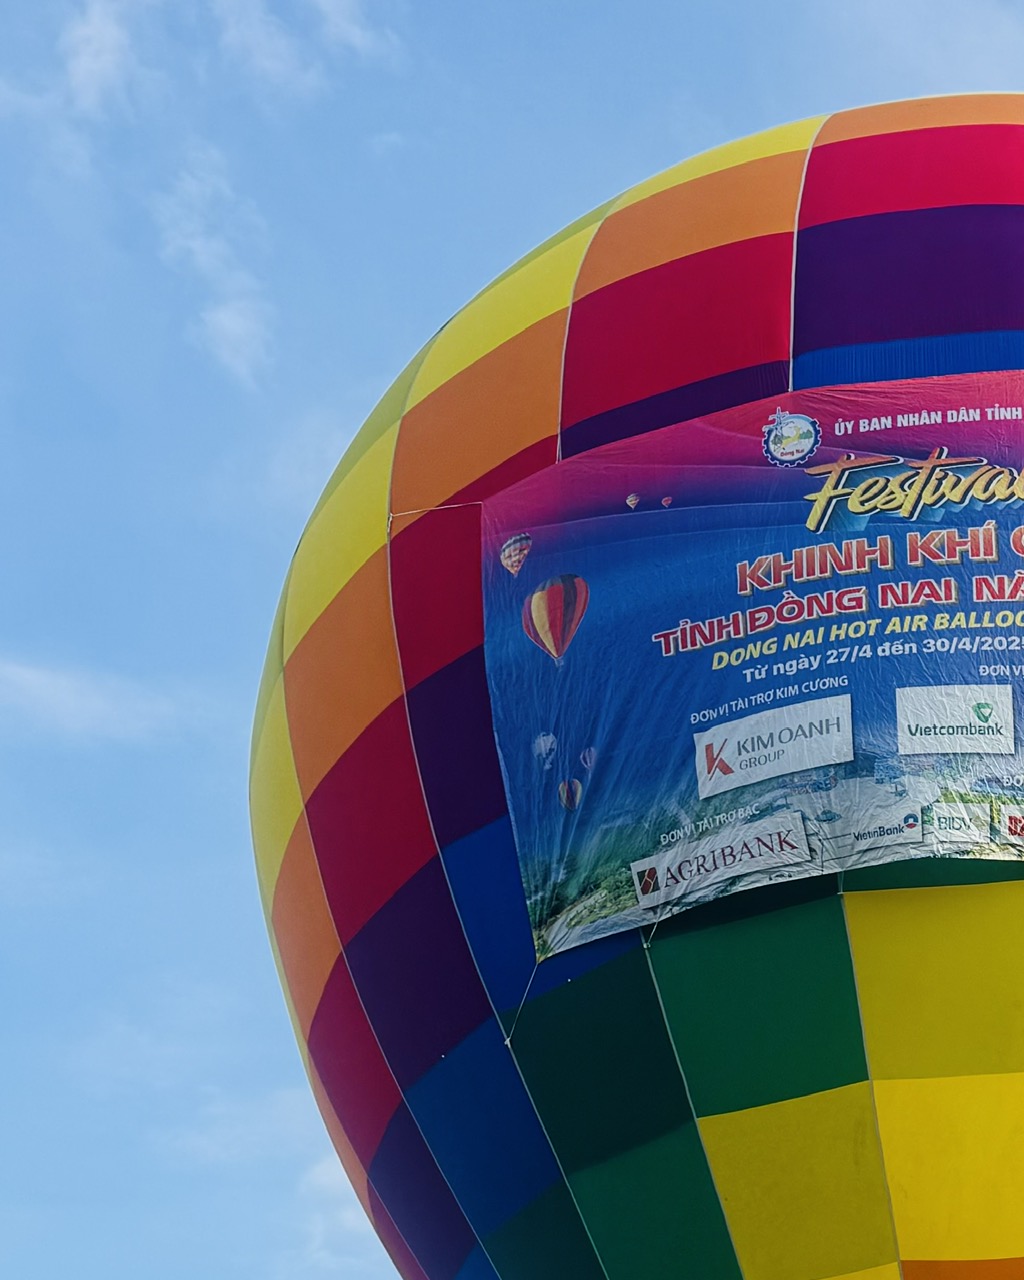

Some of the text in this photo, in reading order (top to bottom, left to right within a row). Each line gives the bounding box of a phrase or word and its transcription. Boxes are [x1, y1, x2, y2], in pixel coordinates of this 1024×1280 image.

[834, 417, 854, 436] ỦY
[859, 412, 893, 432] BAN
[896, 406, 943, 428] NHÂN
[946, 405, 983, 423] DÂN
[985, 403, 1024, 421] TỈNH
[736, 535, 893, 595] KHINH
[907, 519, 999, 567] KHÍ
[653, 616, 745, 657] TỈNH
[748, 586, 867, 634] ĐỒNG
[879, 576, 958, 609] NAI
[711, 639, 777, 670] DONG
[782, 626, 824, 651] NAI
[828, 616, 878, 642] HOT
[884, 614, 928, 634] AIR
[743, 663, 767, 683] Từ
[773, 653, 821, 676] ngày
[826, 645, 872, 664] 27/4
[877, 639, 917, 657] đến
[979, 664, 1010, 677] ĐƠN
[690, 675, 849, 724] ĐƠN VỊ TÀI TRỢ KIM CƯƠNG
[736, 716, 842, 756] KIM OANH
[907, 720, 1004, 737] Vietcombank
[739, 749, 785, 771] GROUP
[737, 803, 761, 820] BẠC
[852, 824, 905, 841] VietinBank
[664, 829, 798, 888] AGRIBANK
